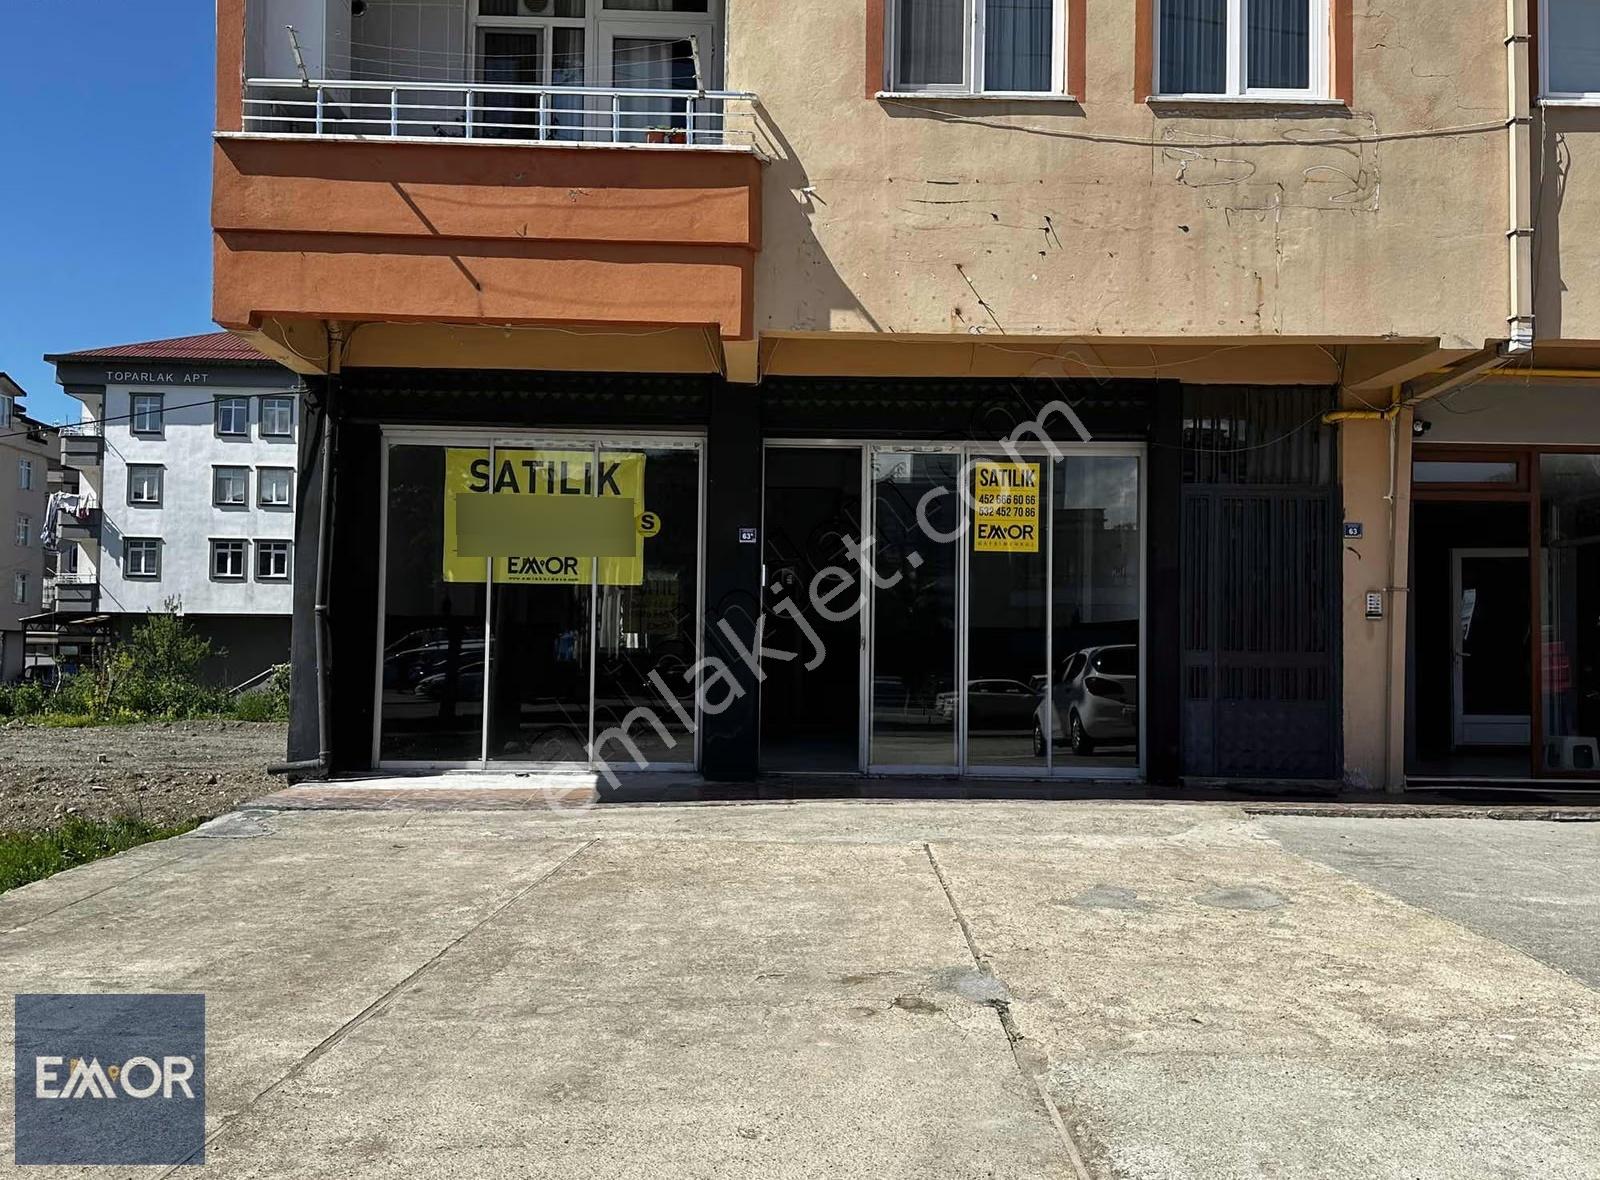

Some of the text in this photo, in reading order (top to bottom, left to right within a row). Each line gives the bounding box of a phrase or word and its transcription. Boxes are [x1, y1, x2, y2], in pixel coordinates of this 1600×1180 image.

[107, 372, 208, 383] TOPARLAK APT
[469, 459, 621, 495] SATILIK
[980, 468, 1035, 487] SATILIK
[979, 495, 994, 504] 452
[1013, 495, 1023, 505] 60
[1026, 496, 1035, 505] 66
[996, 507, 1011, 516] 452
[1014, 508, 1023, 517] 70
[641, 514, 655, 530] S
